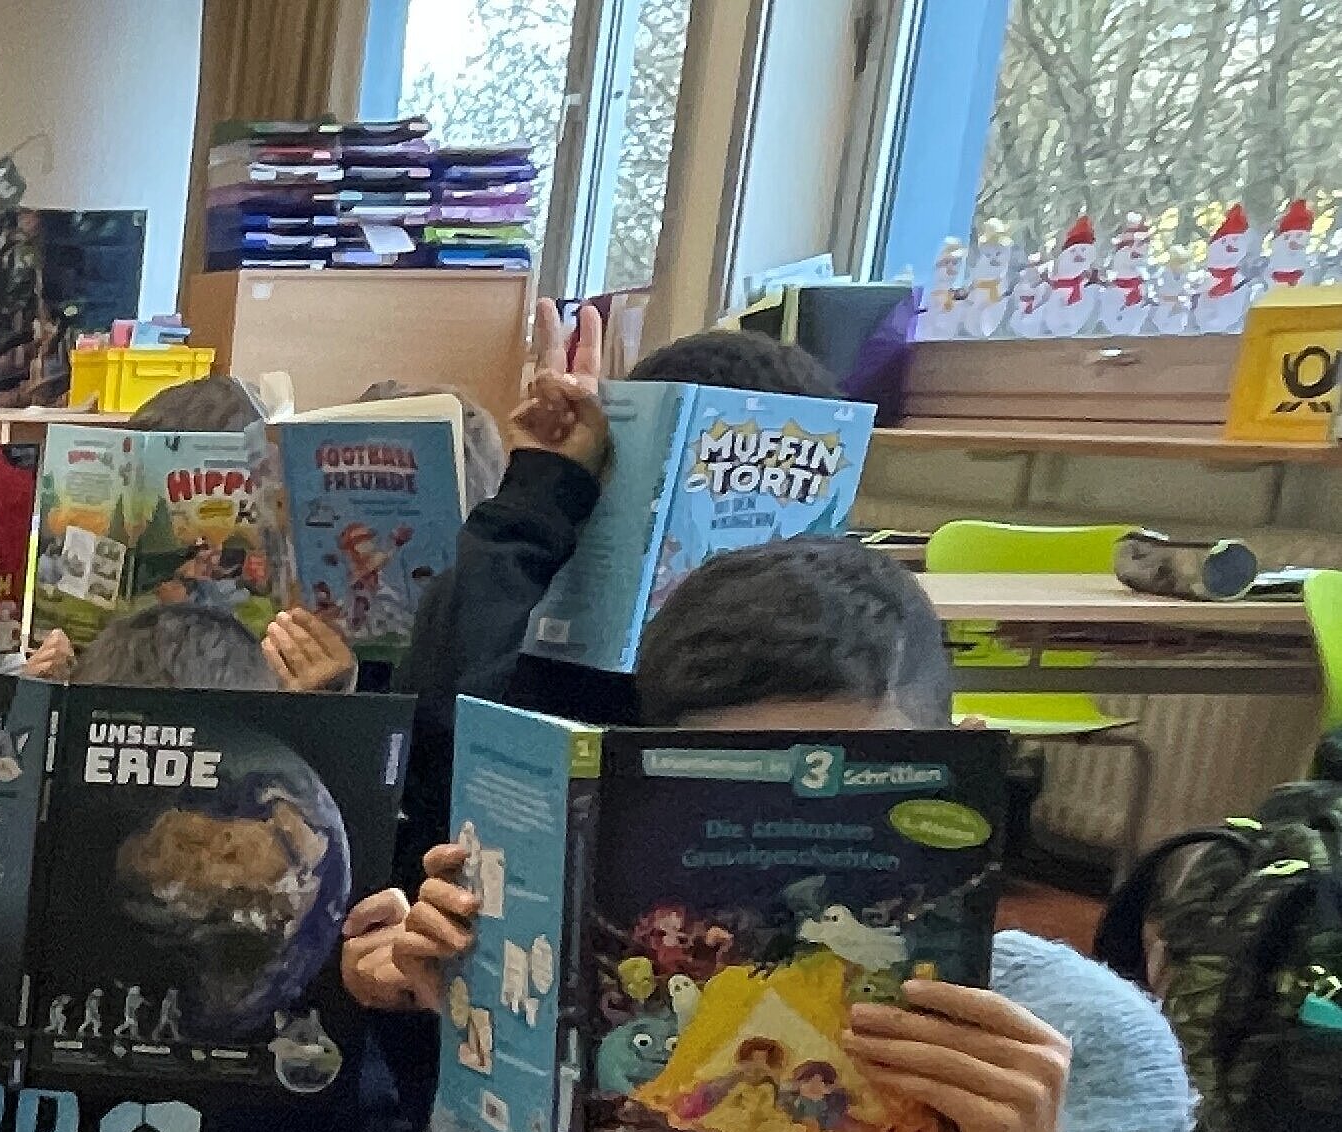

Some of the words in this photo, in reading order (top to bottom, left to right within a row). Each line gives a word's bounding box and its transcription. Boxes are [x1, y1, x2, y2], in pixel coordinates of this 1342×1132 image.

[699, 428, 842, 477] MUFFIN
[88, 723, 196, 746] UNSERE
[84, 747, 223, 789] ERDE
[800, 751, 834, 789] 3
